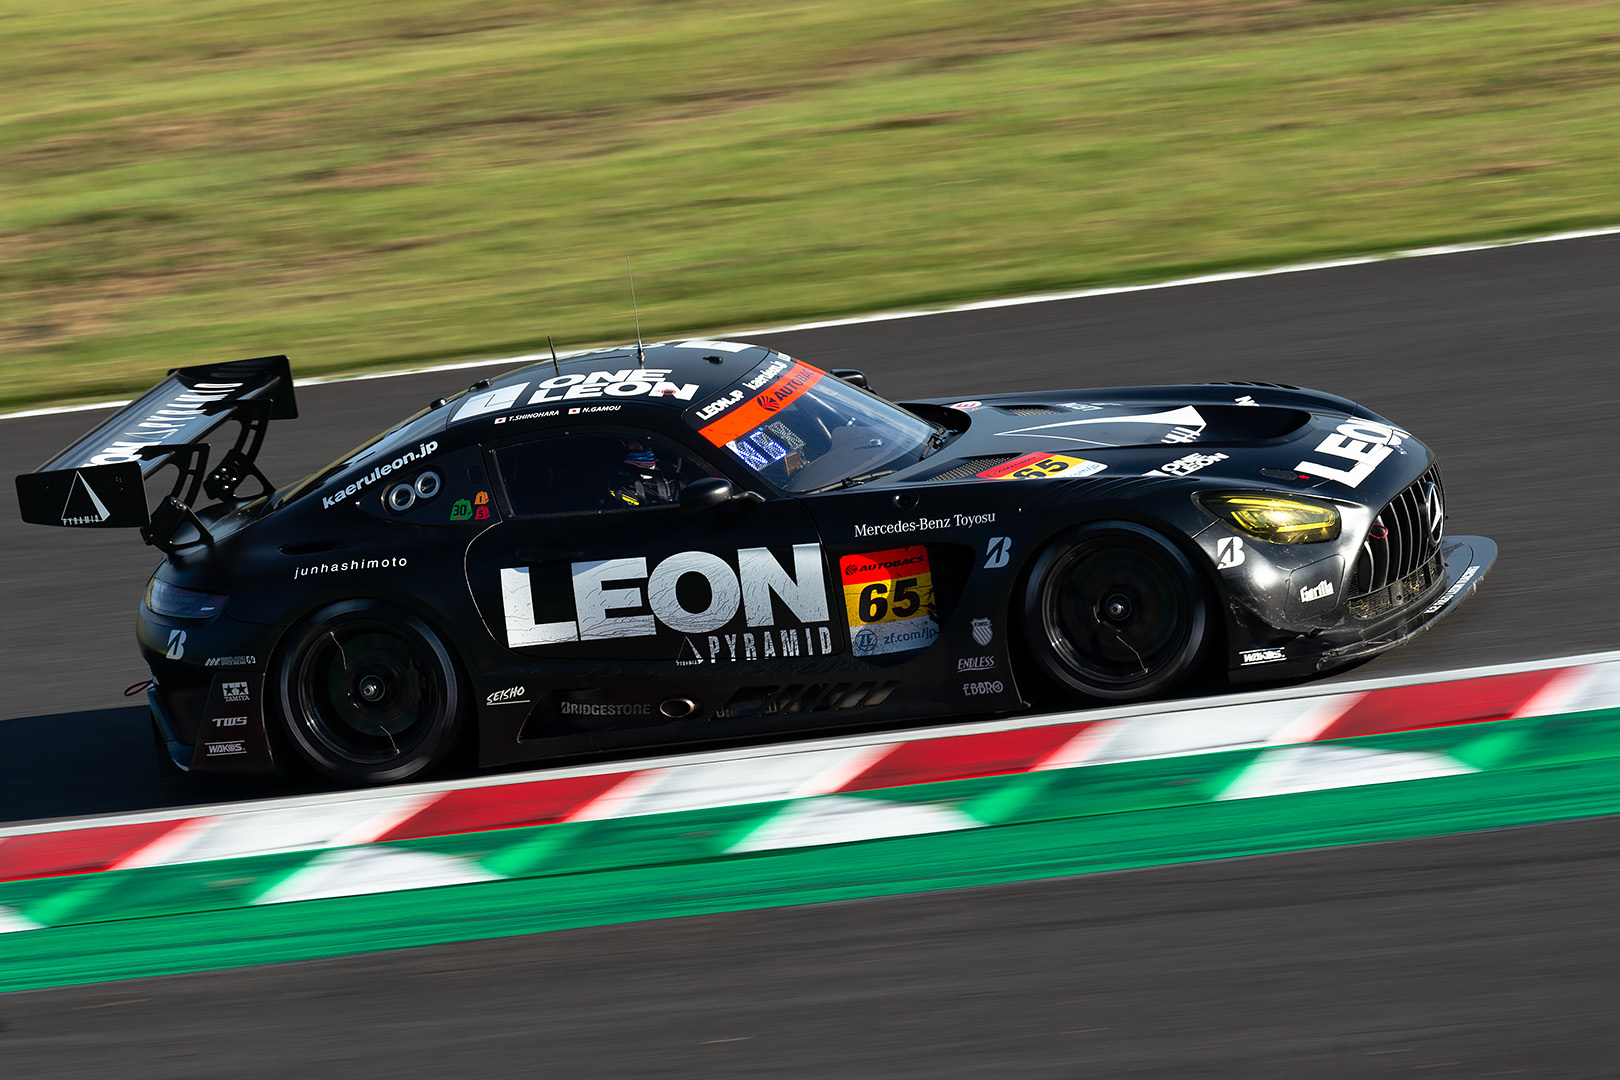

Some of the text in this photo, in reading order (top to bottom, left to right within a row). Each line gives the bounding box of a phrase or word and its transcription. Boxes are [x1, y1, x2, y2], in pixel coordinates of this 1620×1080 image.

[539, 368, 672, 388] ONE
[527, 381, 700, 404] LEON
[508, 410, 560, 422] T.SHINOHARA
[582, 405, 622, 413] N.GAMOU
[1293, 416, 1412, 489] LEON
[321, 440, 439, 510] kaeruleon.jp
[1012, 458, 1070, 480] 65
[452, 504, 467, 517] 30
[854, 512, 996, 538] Mercedes-Benz Toyosu
[293, 556, 408, 580] junhashimoto
[858, 555, 924, 572] AUTOBACS
[500, 543, 830, 649] LEON
[859, 577, 919, 623] 65
[708, 626, 832, 664] PYRAMID
[883, 627, 936, 645] zf.com/jp
[957, 655, 995, 670] ENDLESS
[486, 686, 525, 704] SEISHO
[962, 680, 1004, 696] EBBRO
[561, 701, 651, 716] BRIDGESTONE
[212, 716, 248, 727] TWS
